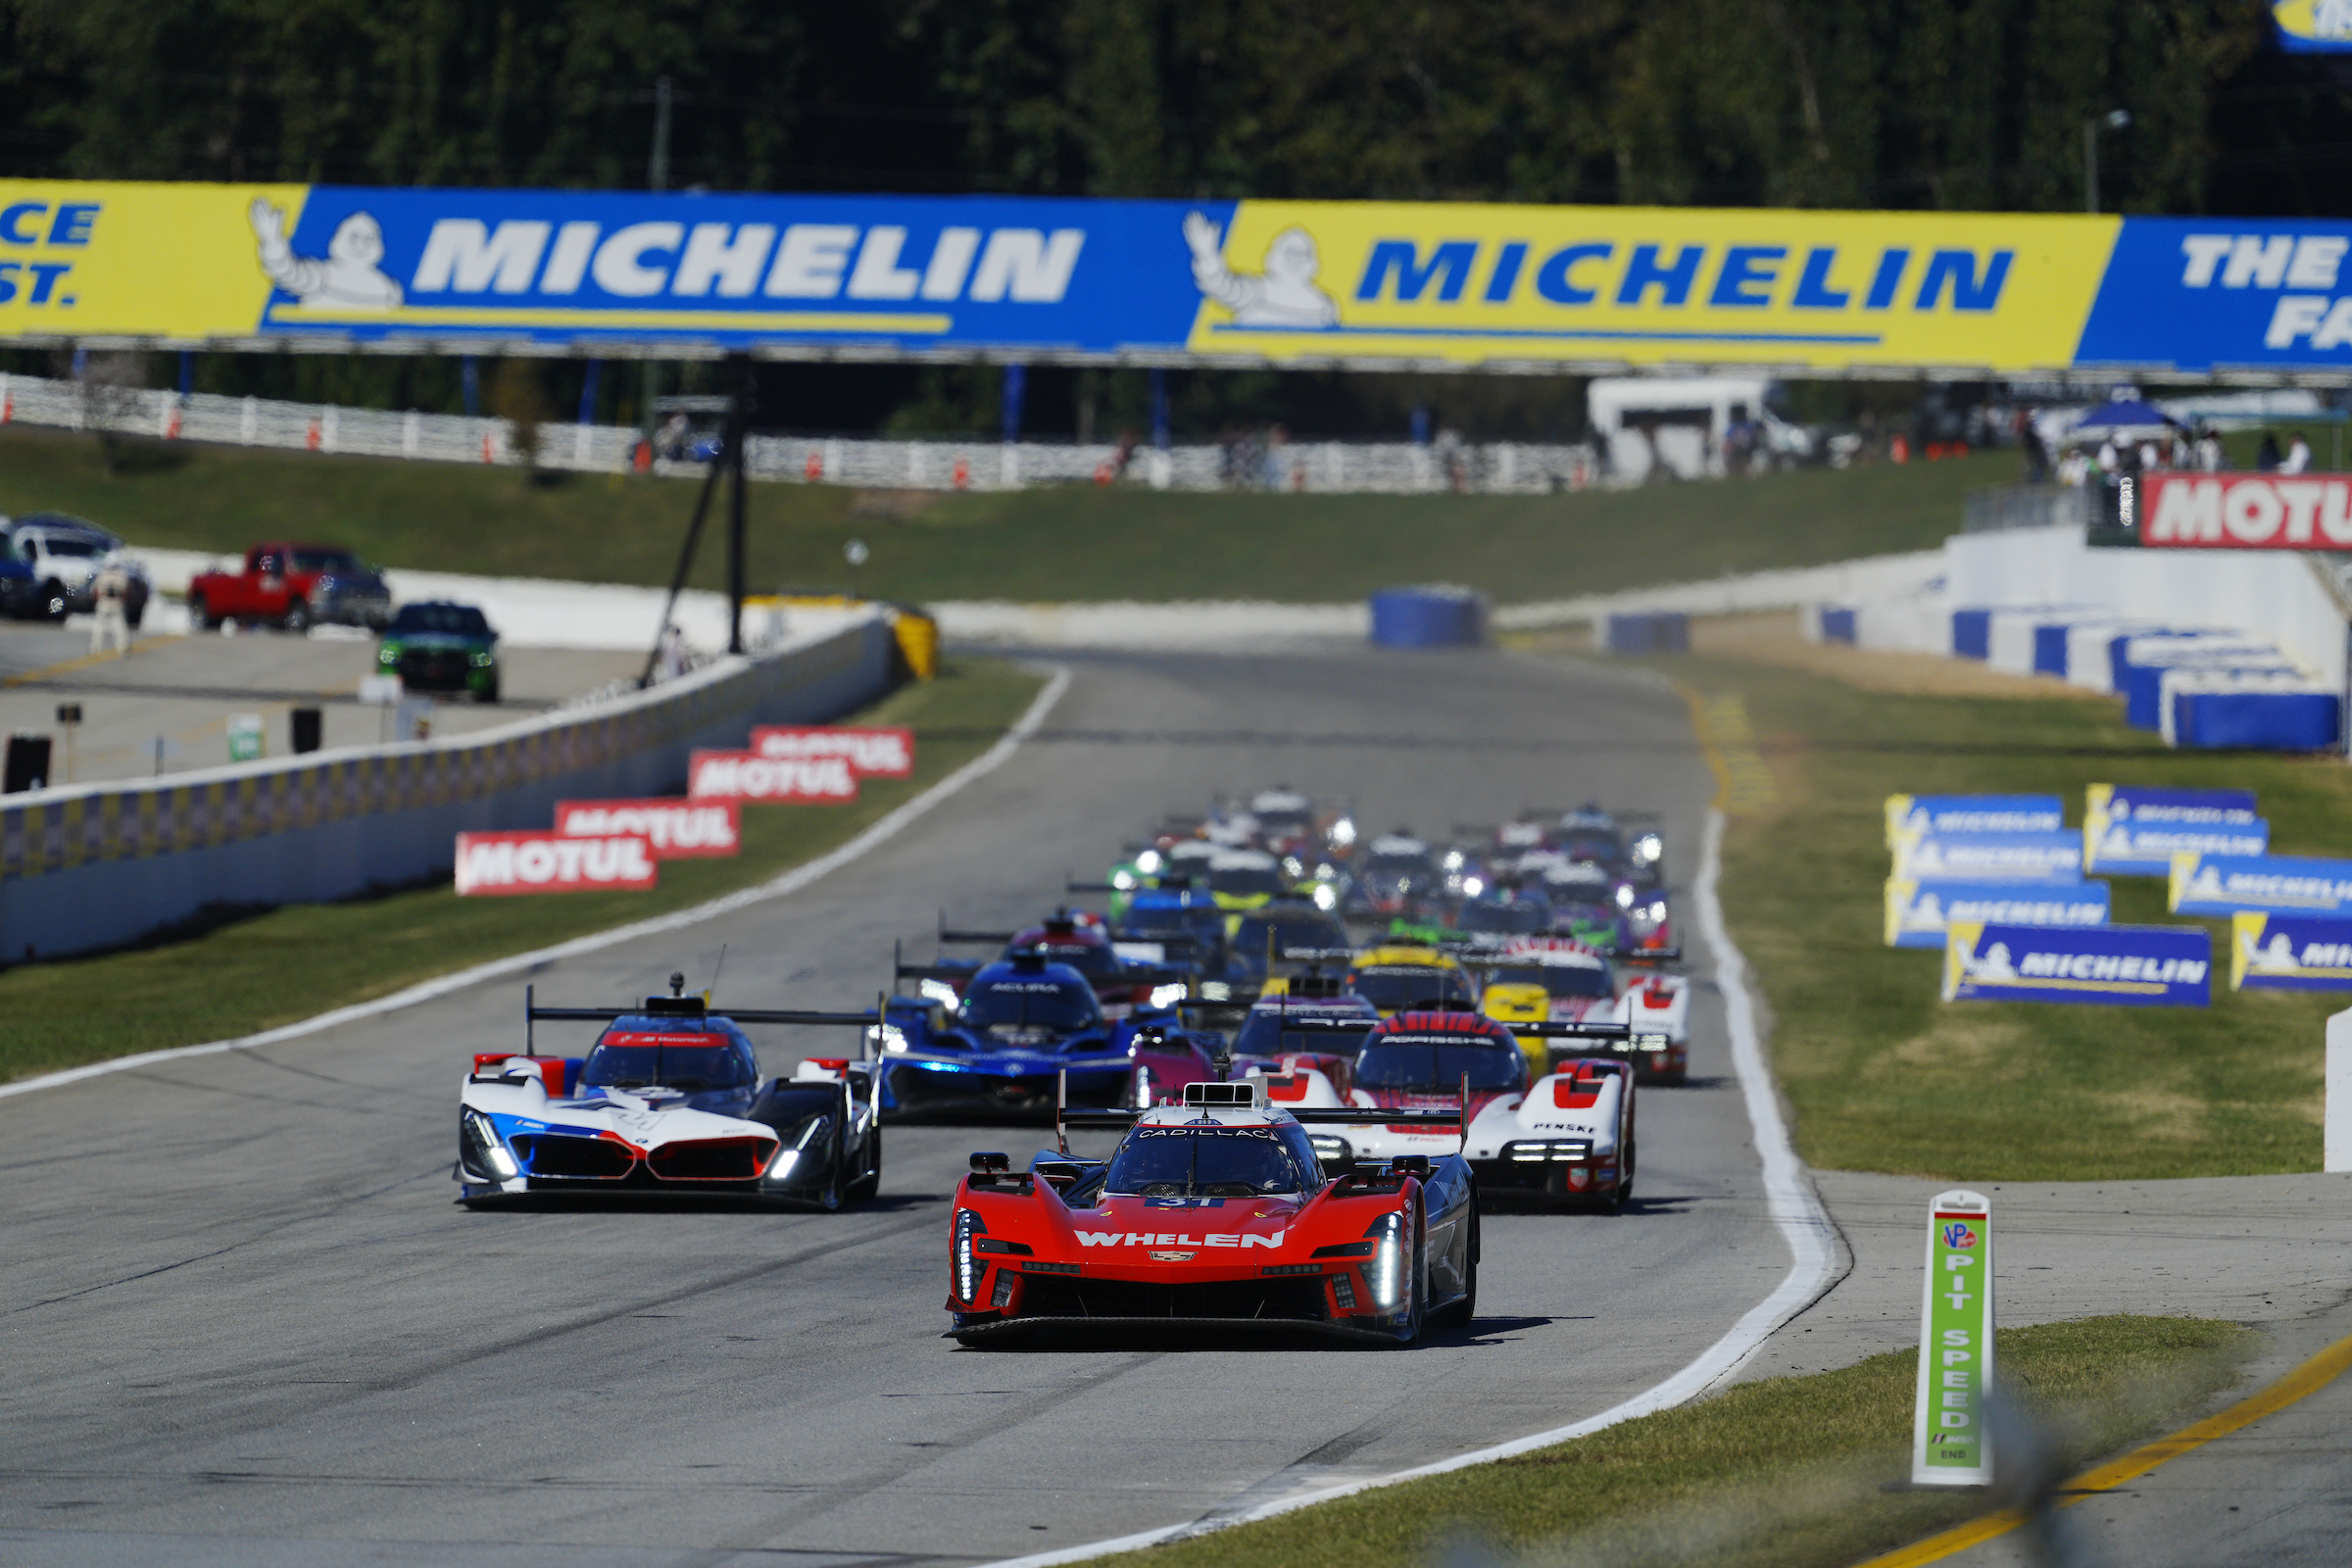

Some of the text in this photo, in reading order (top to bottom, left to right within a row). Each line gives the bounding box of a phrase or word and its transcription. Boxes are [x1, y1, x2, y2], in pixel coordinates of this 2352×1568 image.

[411, 217, 1085, 303] MICHELIN
[1355, 240, 2015, 313] MICHELIN
[2180, 233, 2350, 289] THE
[760, 734, 907, 772] MOTUL
[693, 758, 856, 797] MOTUL
[564, 808, 738, 849] MOTUL
[466, 837, 655, 886] MOTUL
[1947, 900, 2107, 925] MICHELIN
[2019, 952, 2208, 985] MICHELIN
[990, 982, 1060, 993] ACURA
[1380, 1035, 1495, 1047] PORSCHE
[1139, 1128, 1270, 1140] CADILLAC
[1534, 1122, 1596, 1134] PENSKE
[1073, 1229, 1286, 1250] WHELEN
[1944, 1222, 1968, 1249] VP
[1943, 1254, 1975, 1310] PIT
[1939, 1329, 1972, 1428] SPEED
[1940, 1449, 1967, 1459] END
